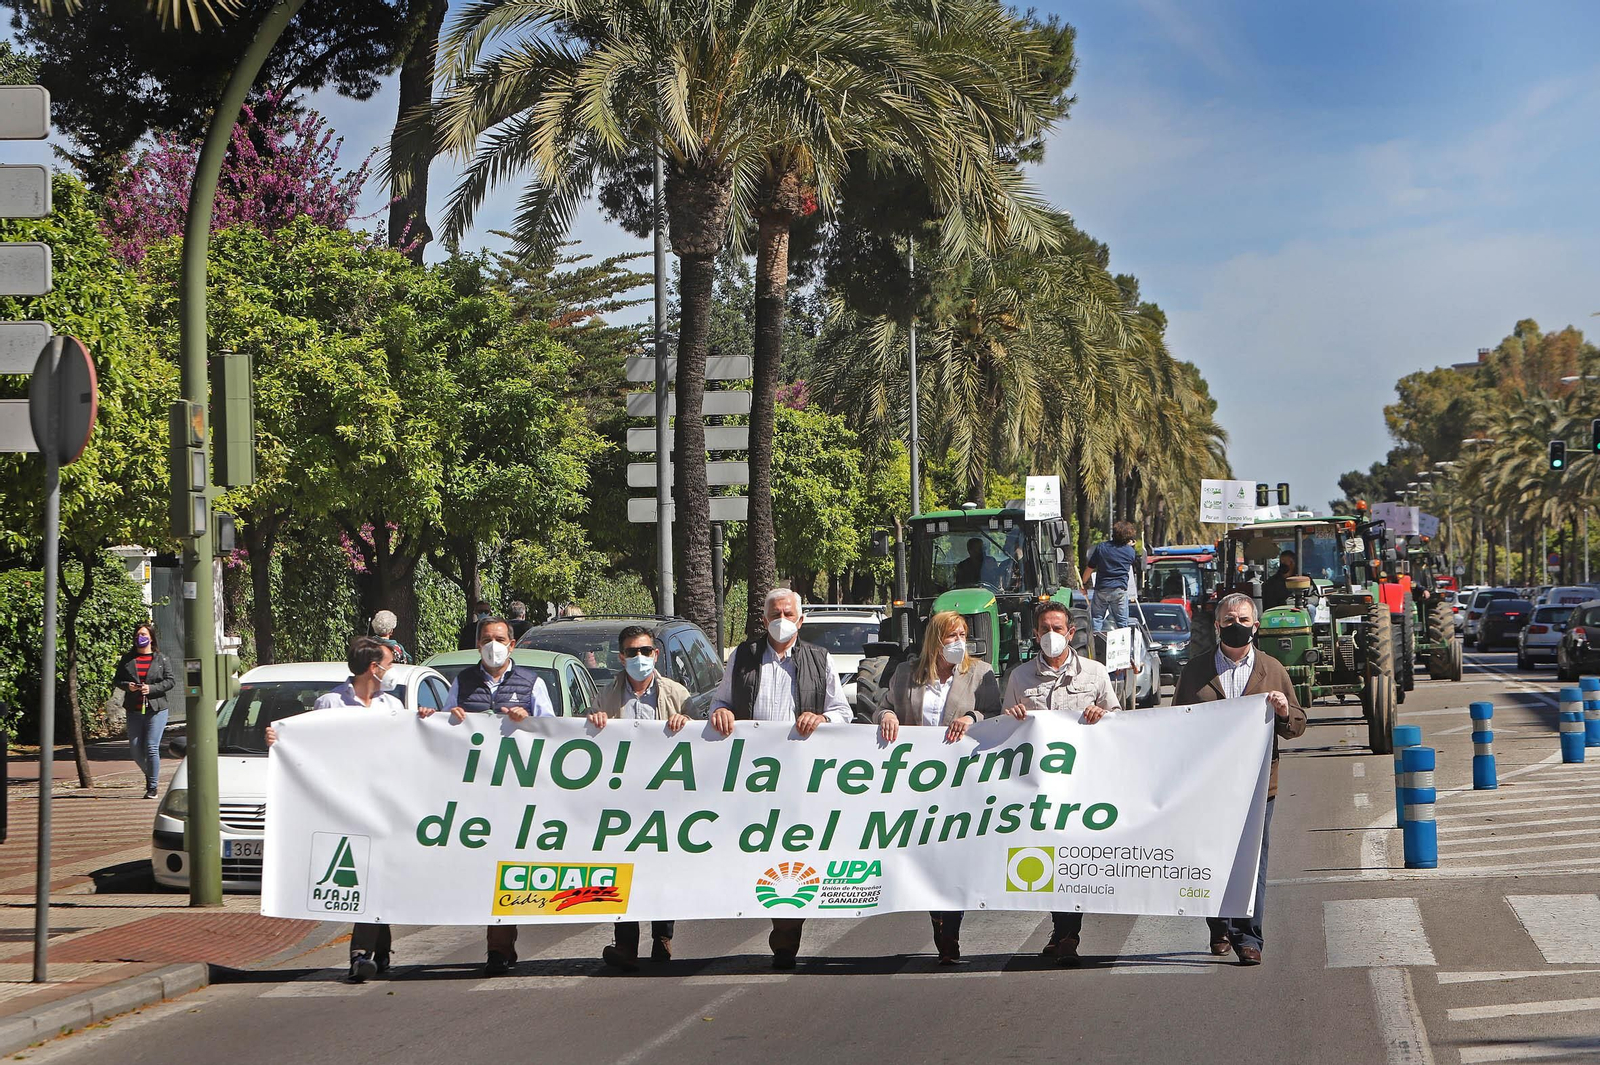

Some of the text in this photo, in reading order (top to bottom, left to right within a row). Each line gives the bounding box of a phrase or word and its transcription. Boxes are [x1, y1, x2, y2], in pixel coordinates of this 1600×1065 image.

[463, 732, 1077, 796] ¡NO! A la reforma
[417, 794, 1118, 854] de la PAC del Ministro
[1058, 845, 1174, 861] cooperativas
[826, 859, 882, 878] UPA
[1058, 862, 1212, 880] agro-alimentarias
[503, 866, 615, 890] COAG
[313, 887, 360, 902] ASAJA
[820, 890, 882, 898] AGRICULTORES
[1057, 883, 1211, 898] Andalucía Cádiz
[499, 892, 549, 908] Cádiz
[827, 896, 880, 904] GANADEROS
